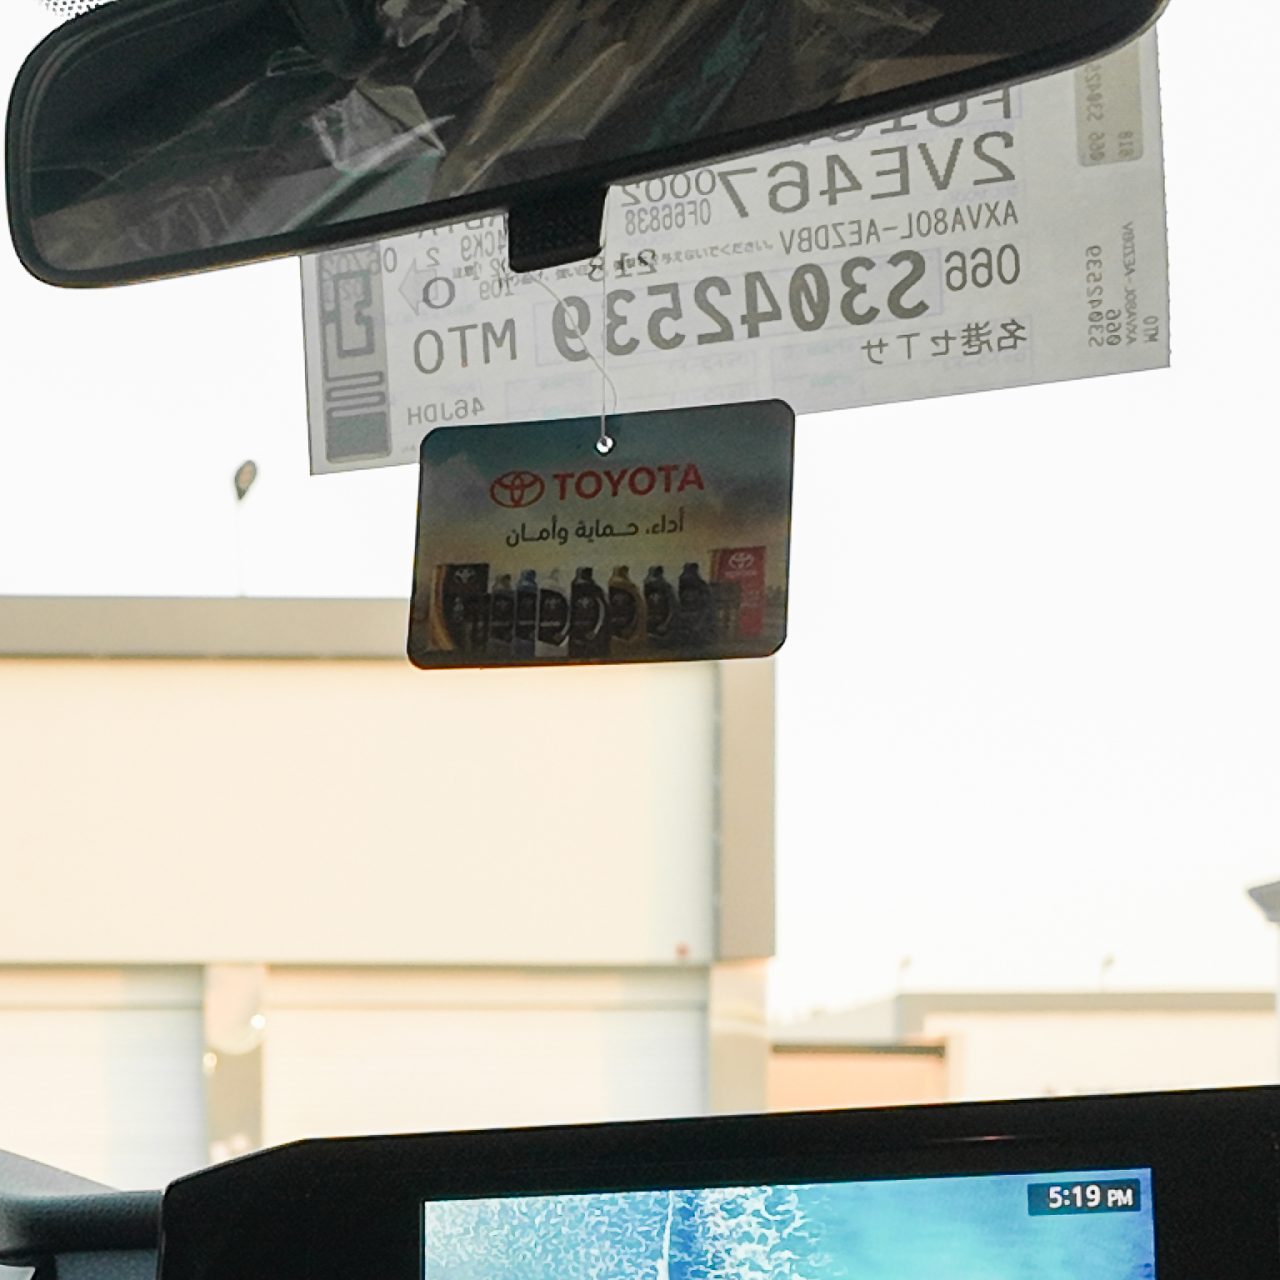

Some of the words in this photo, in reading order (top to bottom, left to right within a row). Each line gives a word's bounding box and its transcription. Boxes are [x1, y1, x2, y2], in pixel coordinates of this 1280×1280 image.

[553, 463, 705, 501] TOYOTA
[1048, 1184, 1101, 1209] 5:19
[1107, 1188, 1133, 1207] PM
